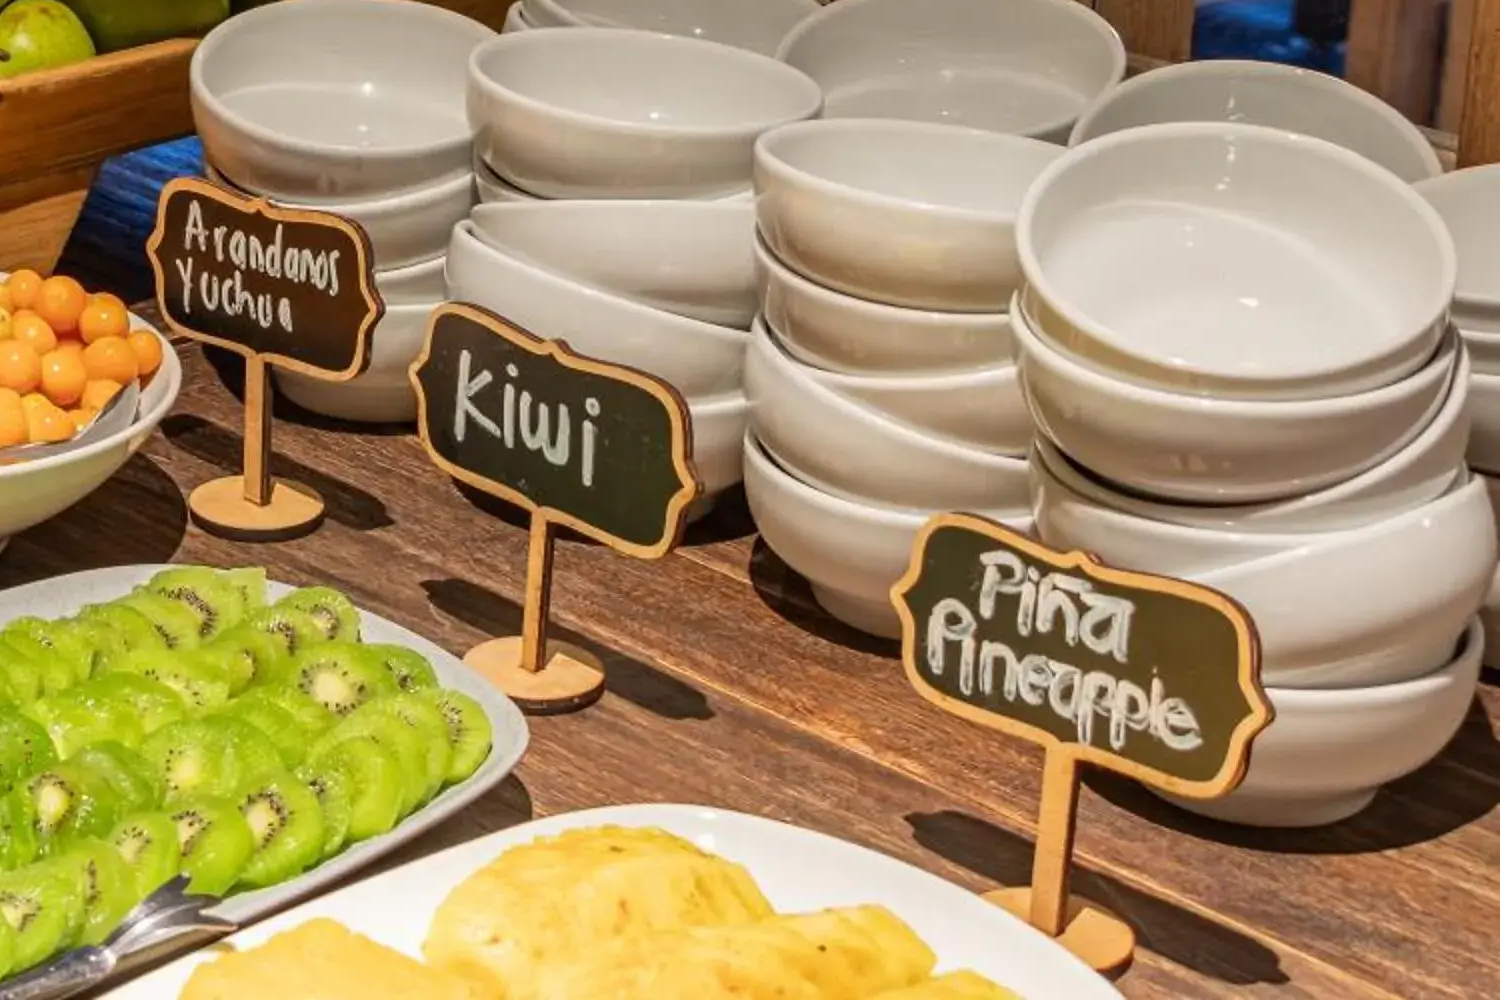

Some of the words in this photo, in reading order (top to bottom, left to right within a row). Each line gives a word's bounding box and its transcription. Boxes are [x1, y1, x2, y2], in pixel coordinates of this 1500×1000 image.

[184, 199, 341, 297] Arandanos
[453, 349, 601, 488] Kiwi
[979, 550, 1136, 664] Piña
[926, 598, 1204, 751] Pineapple
